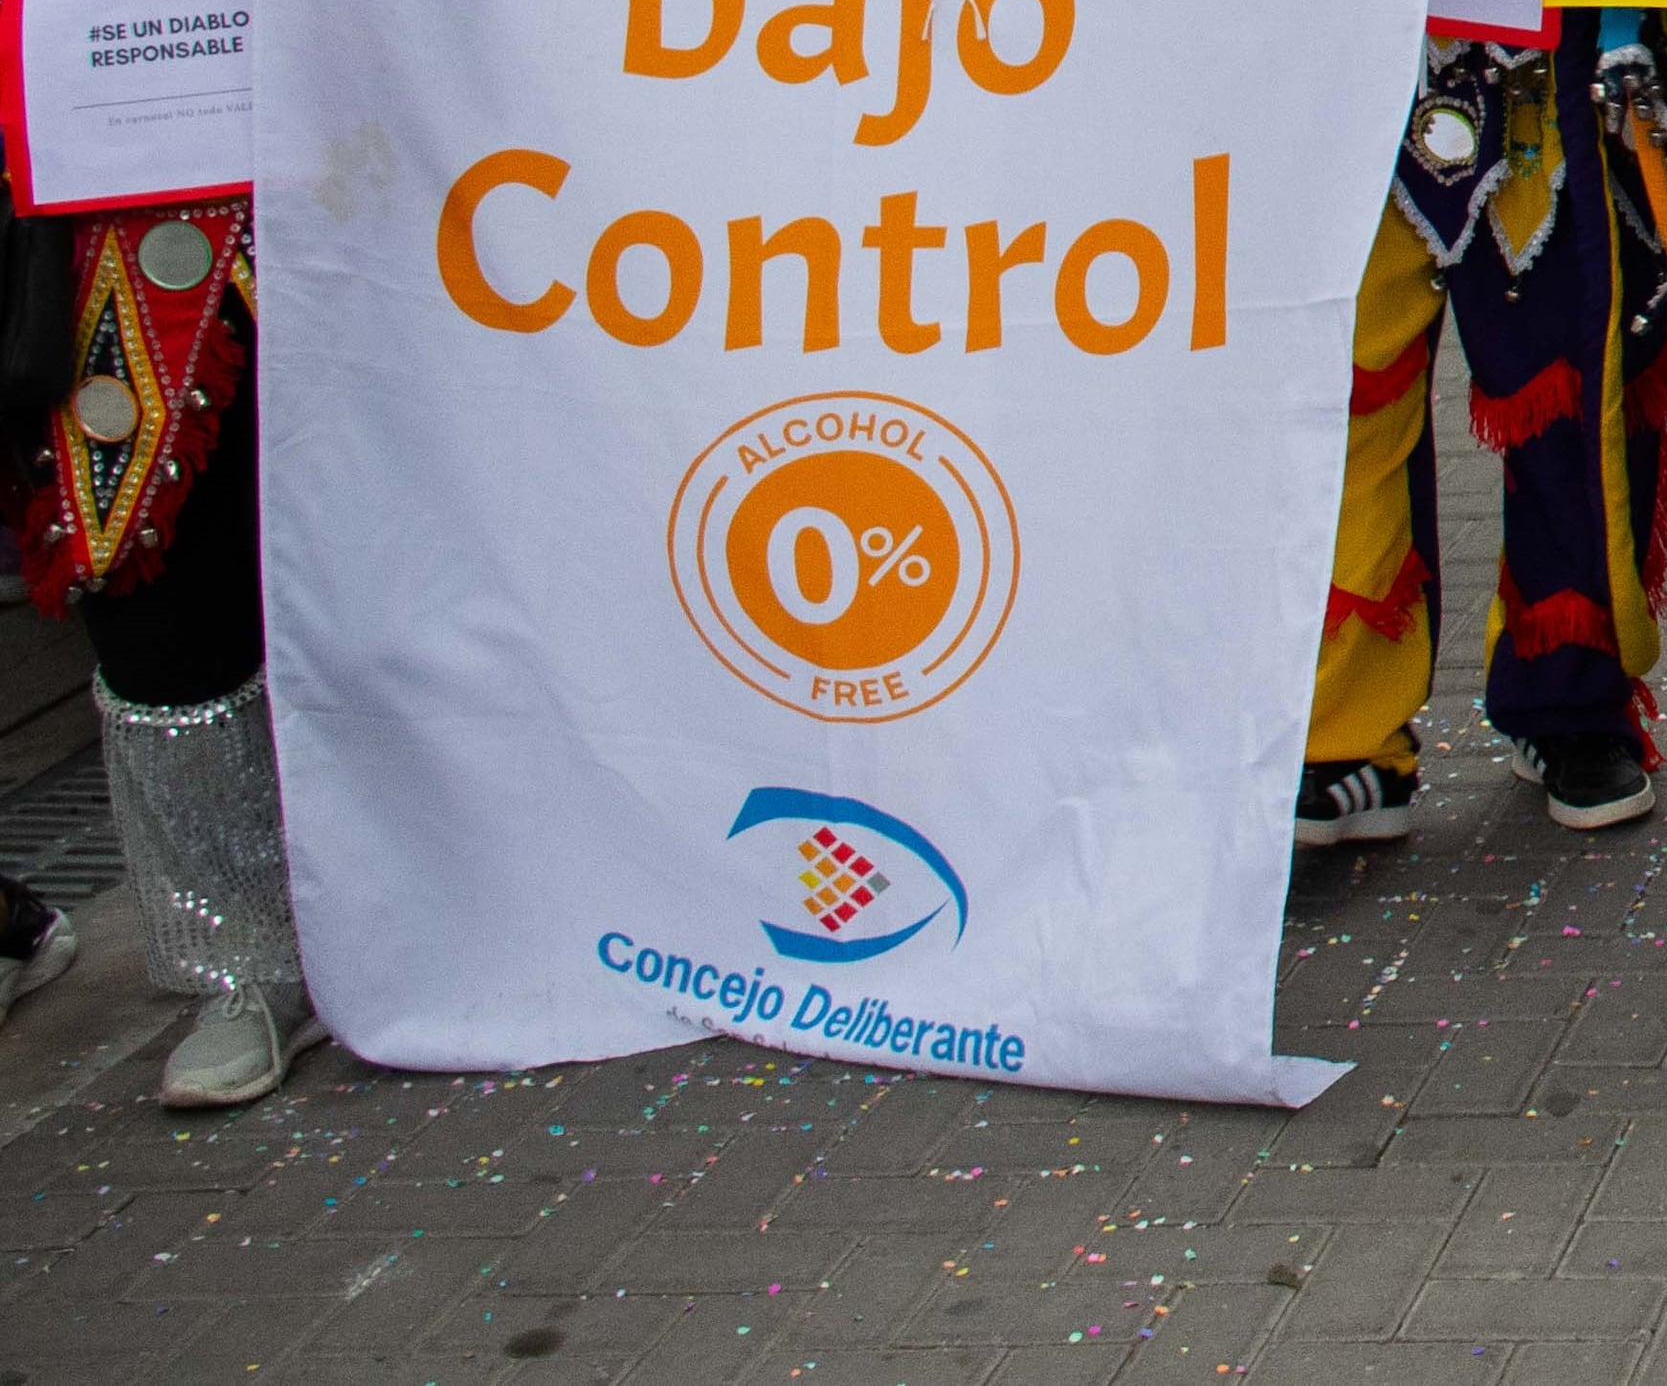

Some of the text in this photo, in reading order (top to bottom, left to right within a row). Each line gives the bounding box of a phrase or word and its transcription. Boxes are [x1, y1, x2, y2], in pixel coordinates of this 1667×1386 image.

[88, 10, 250, 43] #SE UN DIABLO
[90, 35, 244, 68] RESPONSABLE
[437, 147, 1232, 357] Control
[735, 411, 928, 474] ALCOHOL
[766, 505, 932, 626] 0%
[810, 671, 911, 708] FREE
[595, 931, 785, 1025] Concejo
[790, 983, 1026, 1074] Deliberante
